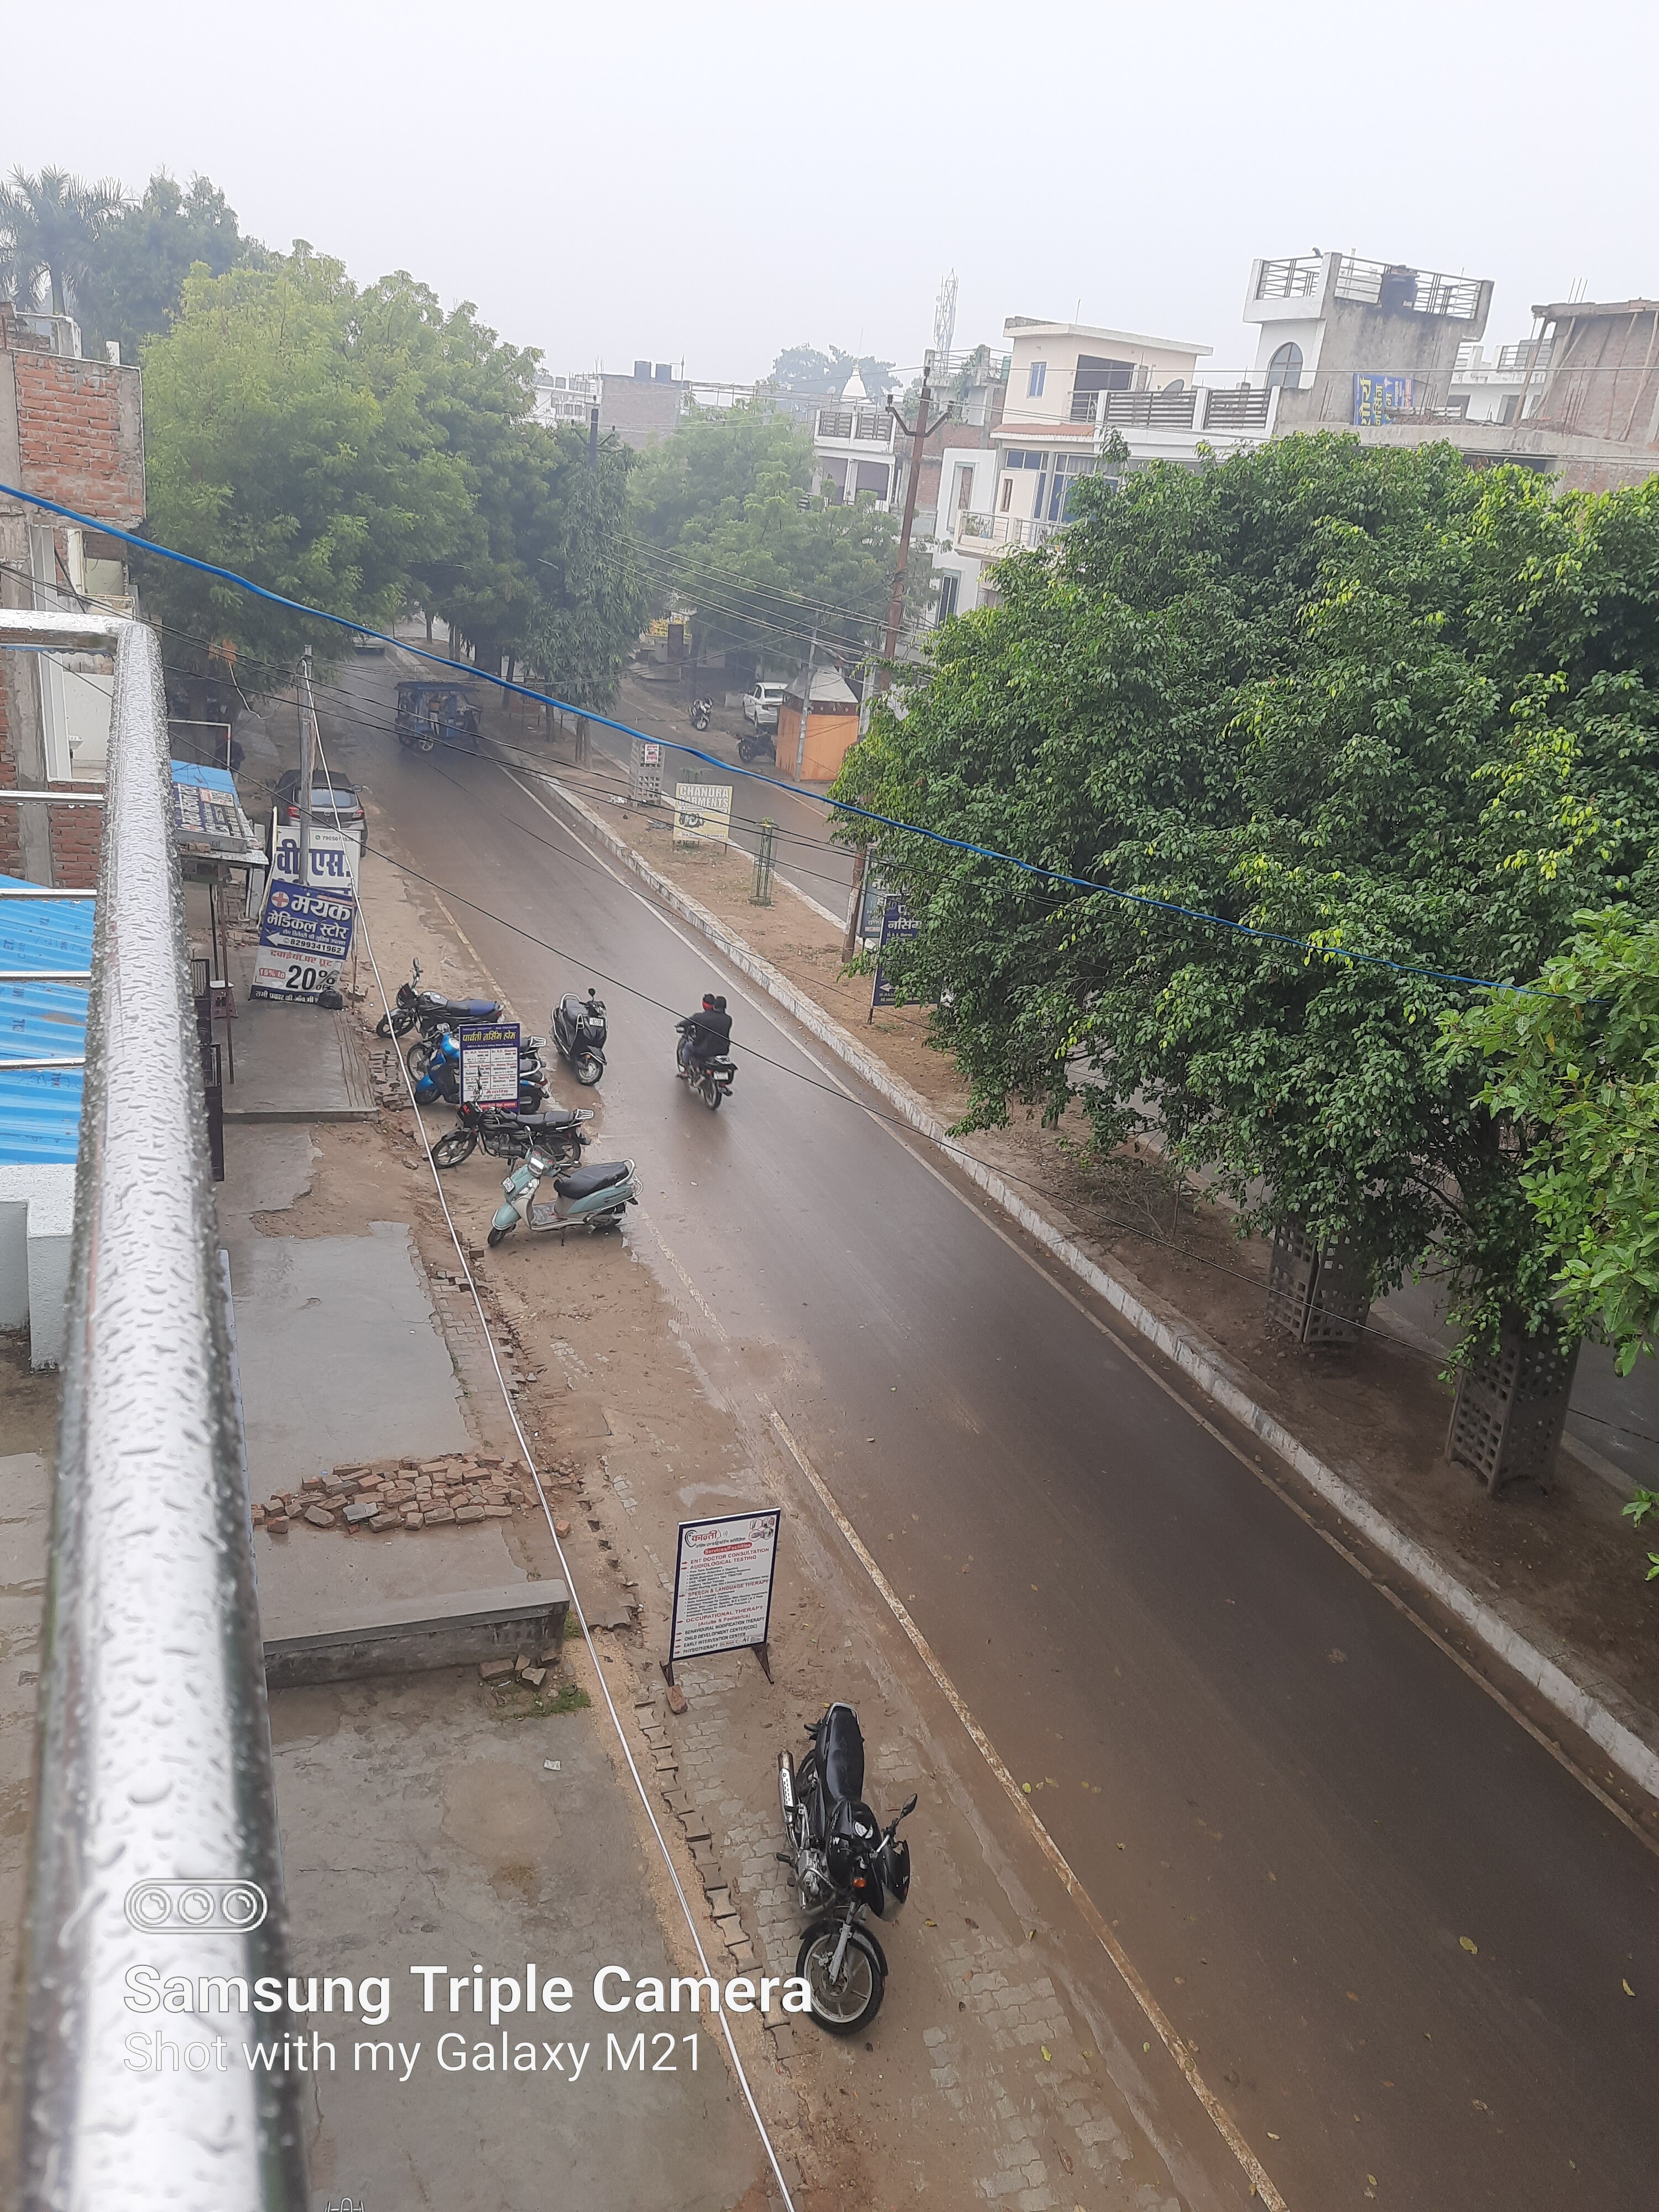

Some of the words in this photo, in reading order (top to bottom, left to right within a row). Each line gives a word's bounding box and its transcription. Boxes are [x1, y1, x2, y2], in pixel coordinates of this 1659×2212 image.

[680, 786, 728, 797] CHANDRA
[679, 796, 728, 807] GARMENTS
[267, 910, 318, 933] मेडिकल
[320, 922, 349, 940] स्टोर
[290, 938, 341, 953] 8299341962
[286, 964, 336, 990] 20%
[463, 1031, 482, 1042] पार्वती
[728, 1547, 769, 1558] CONSULTATION
[686, 1610, 733, 1623] OCCUPATIONAL
[734, 1605, 763, 1614] THERAPY
